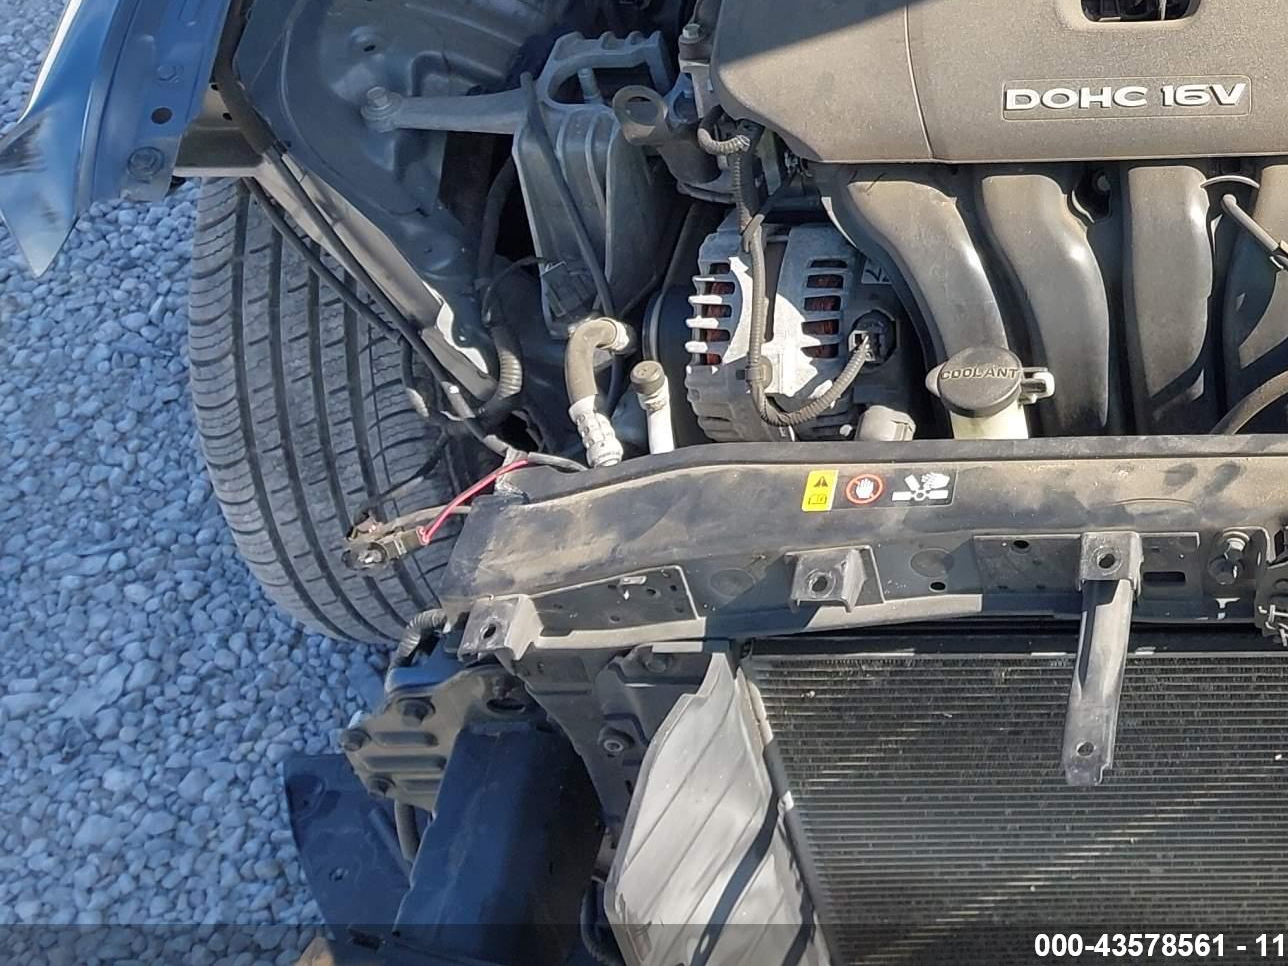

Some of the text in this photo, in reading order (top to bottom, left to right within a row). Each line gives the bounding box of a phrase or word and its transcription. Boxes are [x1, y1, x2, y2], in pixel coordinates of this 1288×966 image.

[1004, 83, 1247, 111] DOHC 16V
[940, 367, 1018, 380] COOLANT
